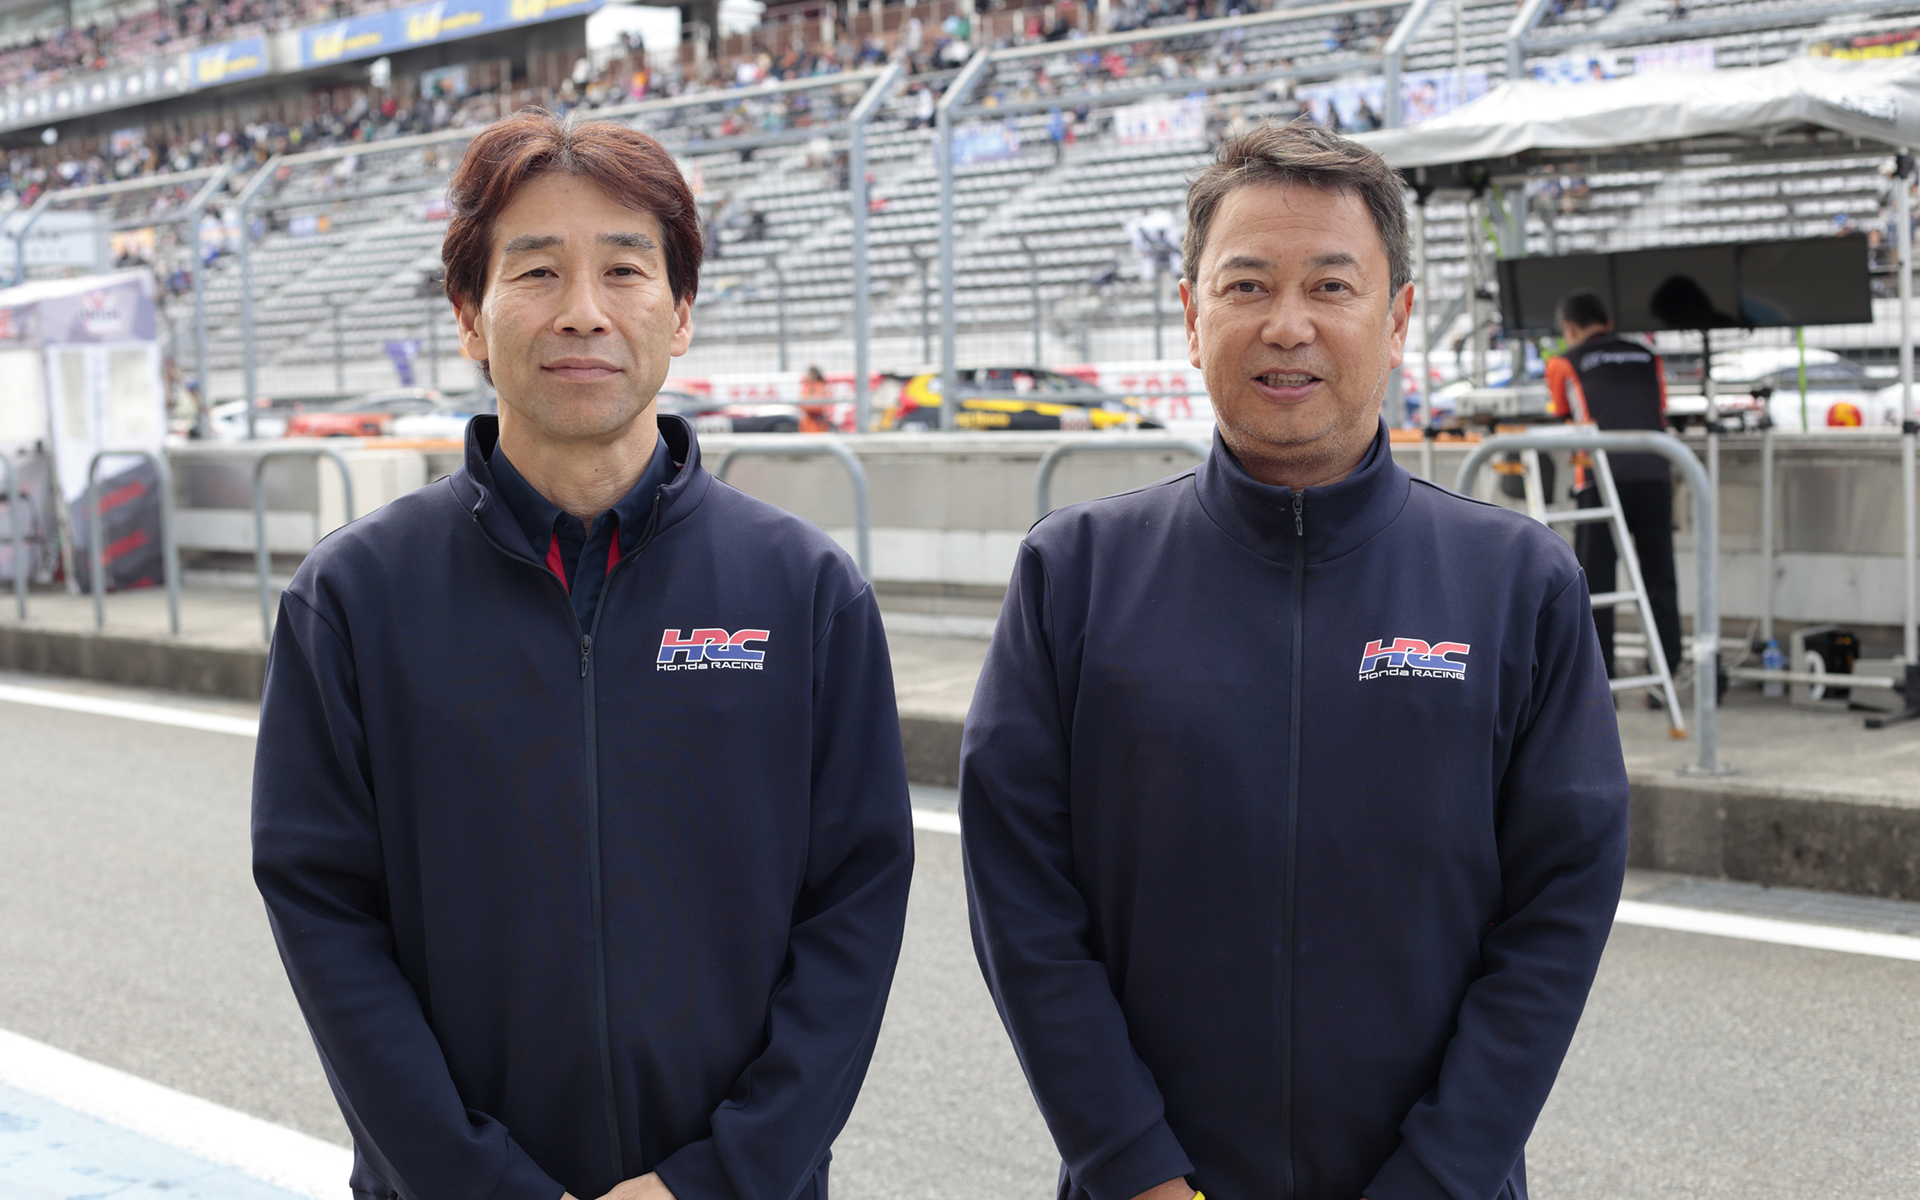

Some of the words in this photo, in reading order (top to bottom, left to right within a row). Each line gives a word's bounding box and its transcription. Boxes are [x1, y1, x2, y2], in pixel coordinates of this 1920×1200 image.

[656, 628, 770, 663] HRC
[1358, 637, 1471, 674] HRC
[656, 662, 708, 671] Honda
[711, 661, 764, 670] RACING
[1358, 668, 1410, 682] Honda
[1412, 669, 1465, 681] RACING
